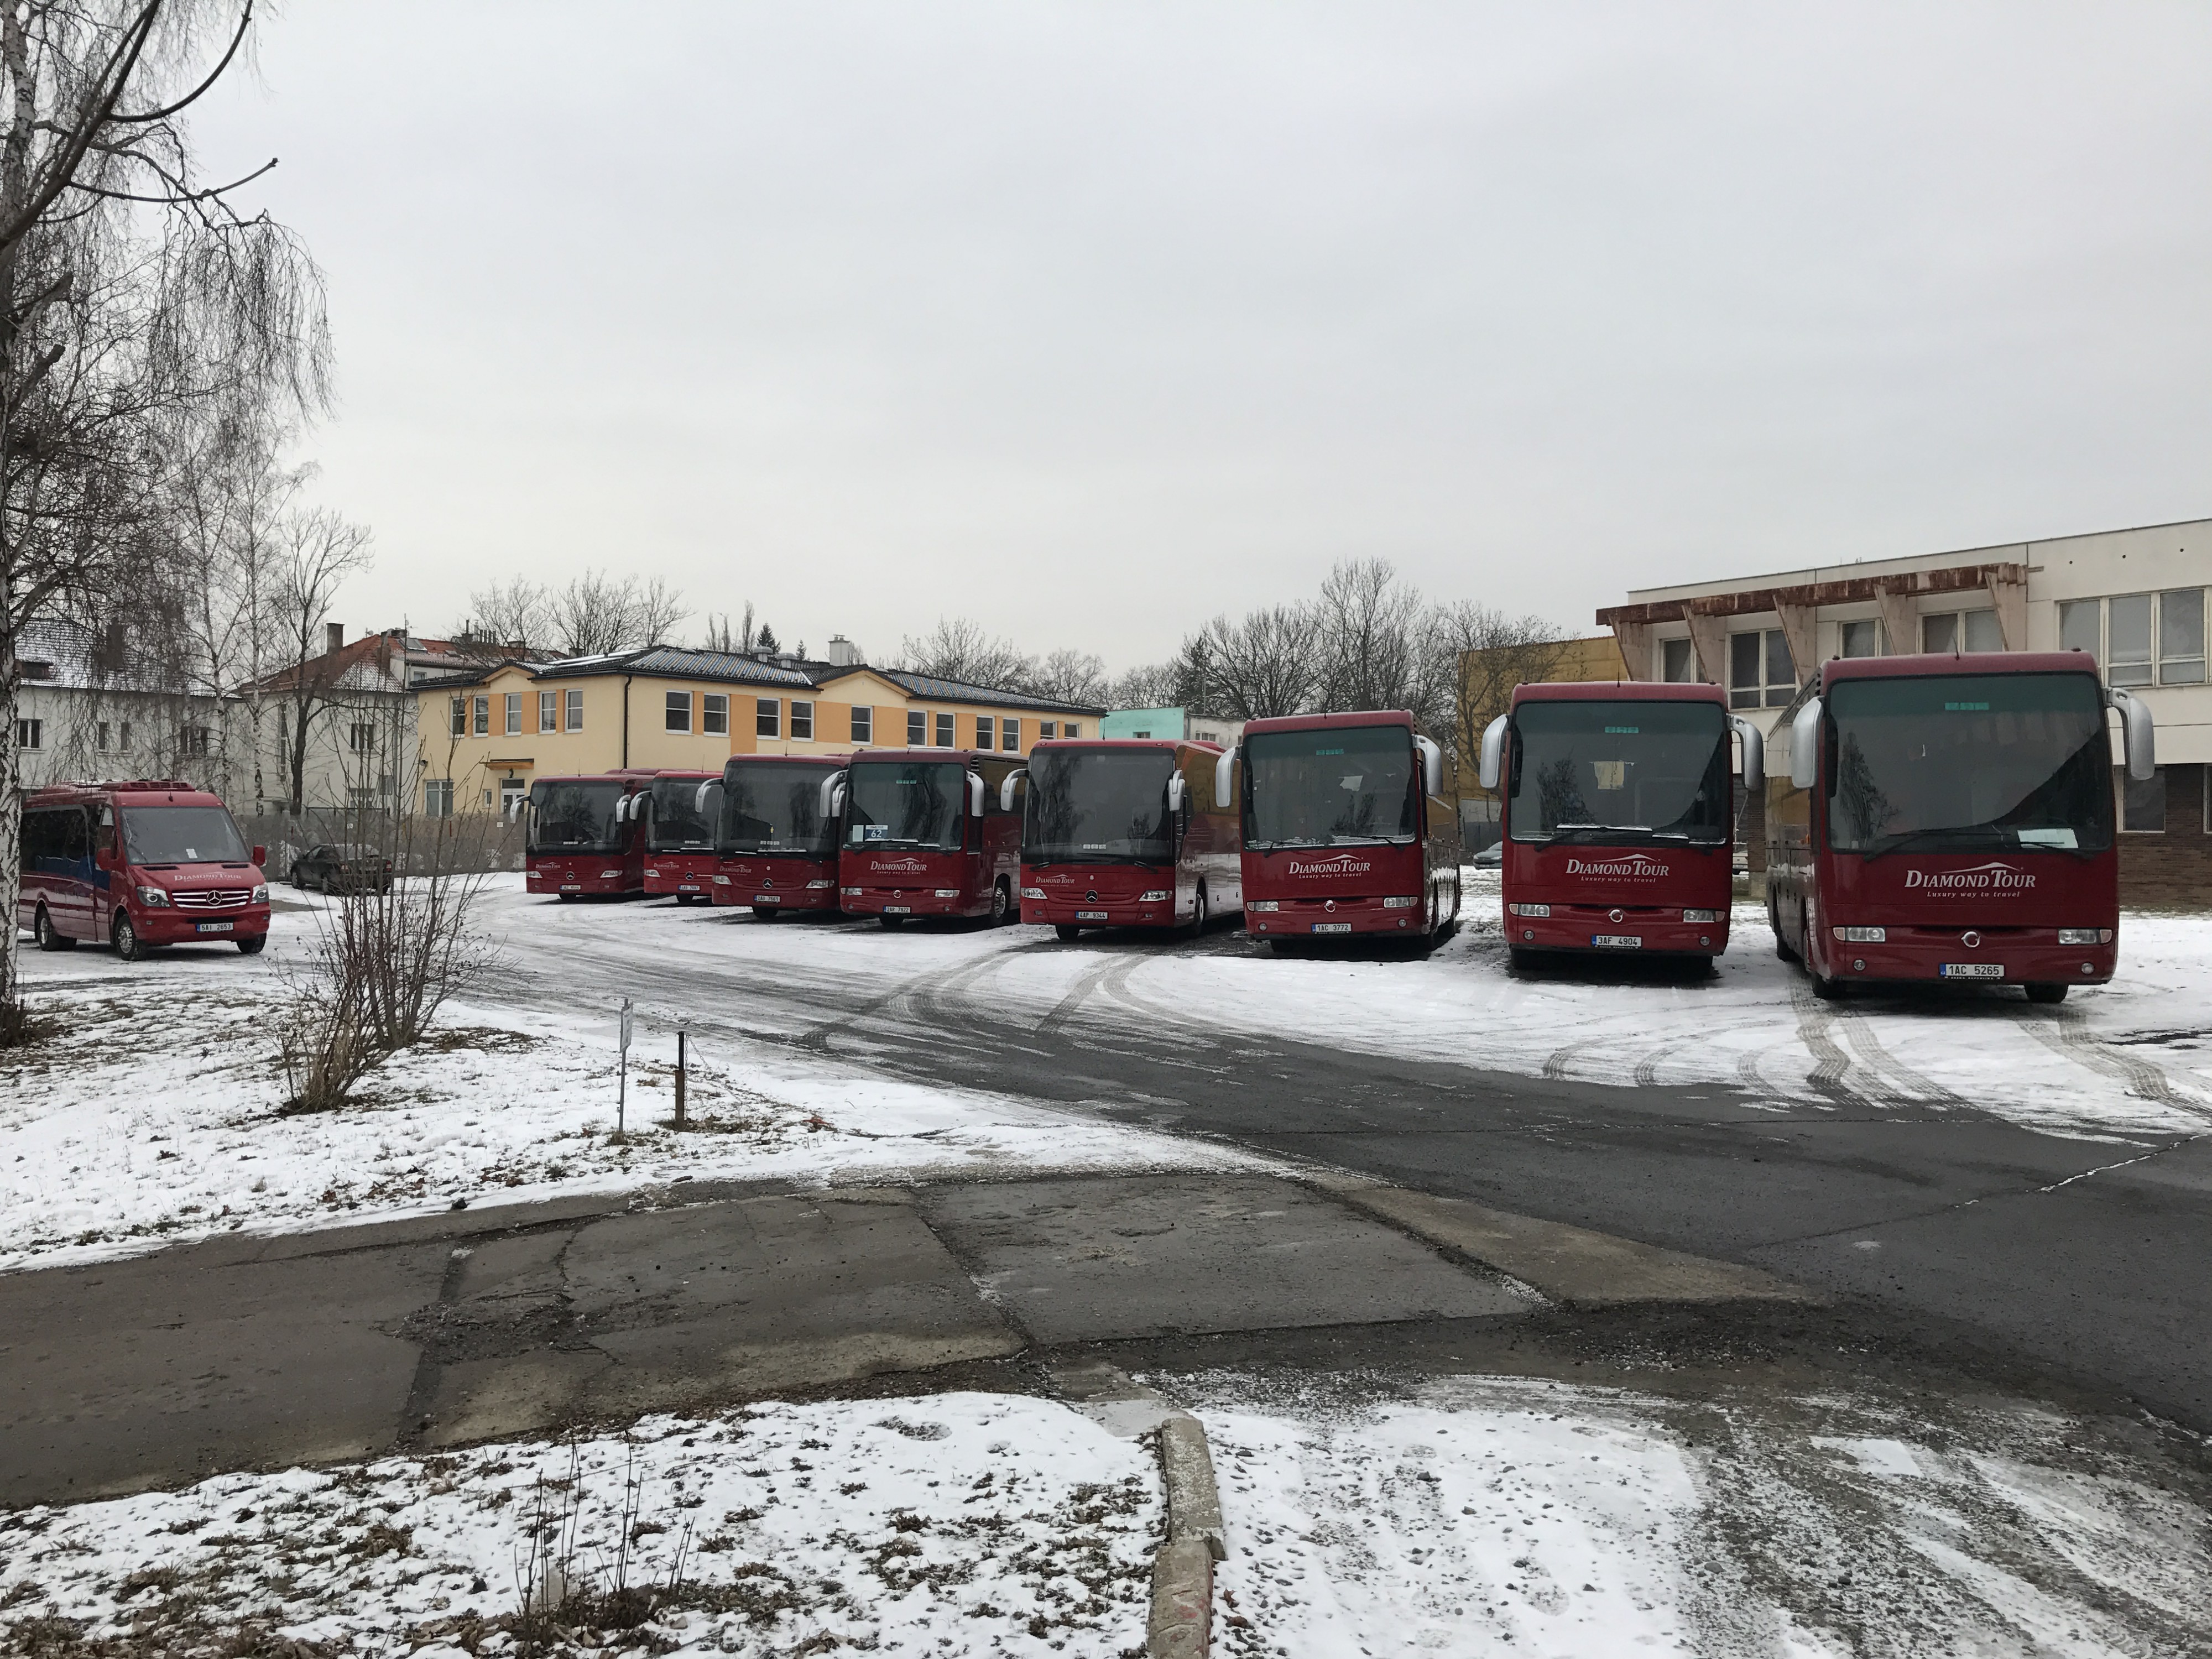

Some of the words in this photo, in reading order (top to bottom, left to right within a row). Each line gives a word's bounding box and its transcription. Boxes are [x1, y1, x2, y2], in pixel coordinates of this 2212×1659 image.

[870, 830, 882, 838] 62
[870, 860, 906, 871] DIAMOND
[906, 861, 927, 871] TOUR
[1288, 861, 1340, 874] DIAMOND
[1341, 859, 1370, 872] TOUR
[1566, 859, 1631, 875] DIAMOND
[1632, 860, 1669, 876] TOUR
[1905, 870, 1990, 888] DIAMOND
[1991, 870, 2036, 888] TOUR
[1618, 937, 1637, 946] 4904
[1949, 965, 1967, 974] 1AC
[1974, 966, 1999, 975] 5265
